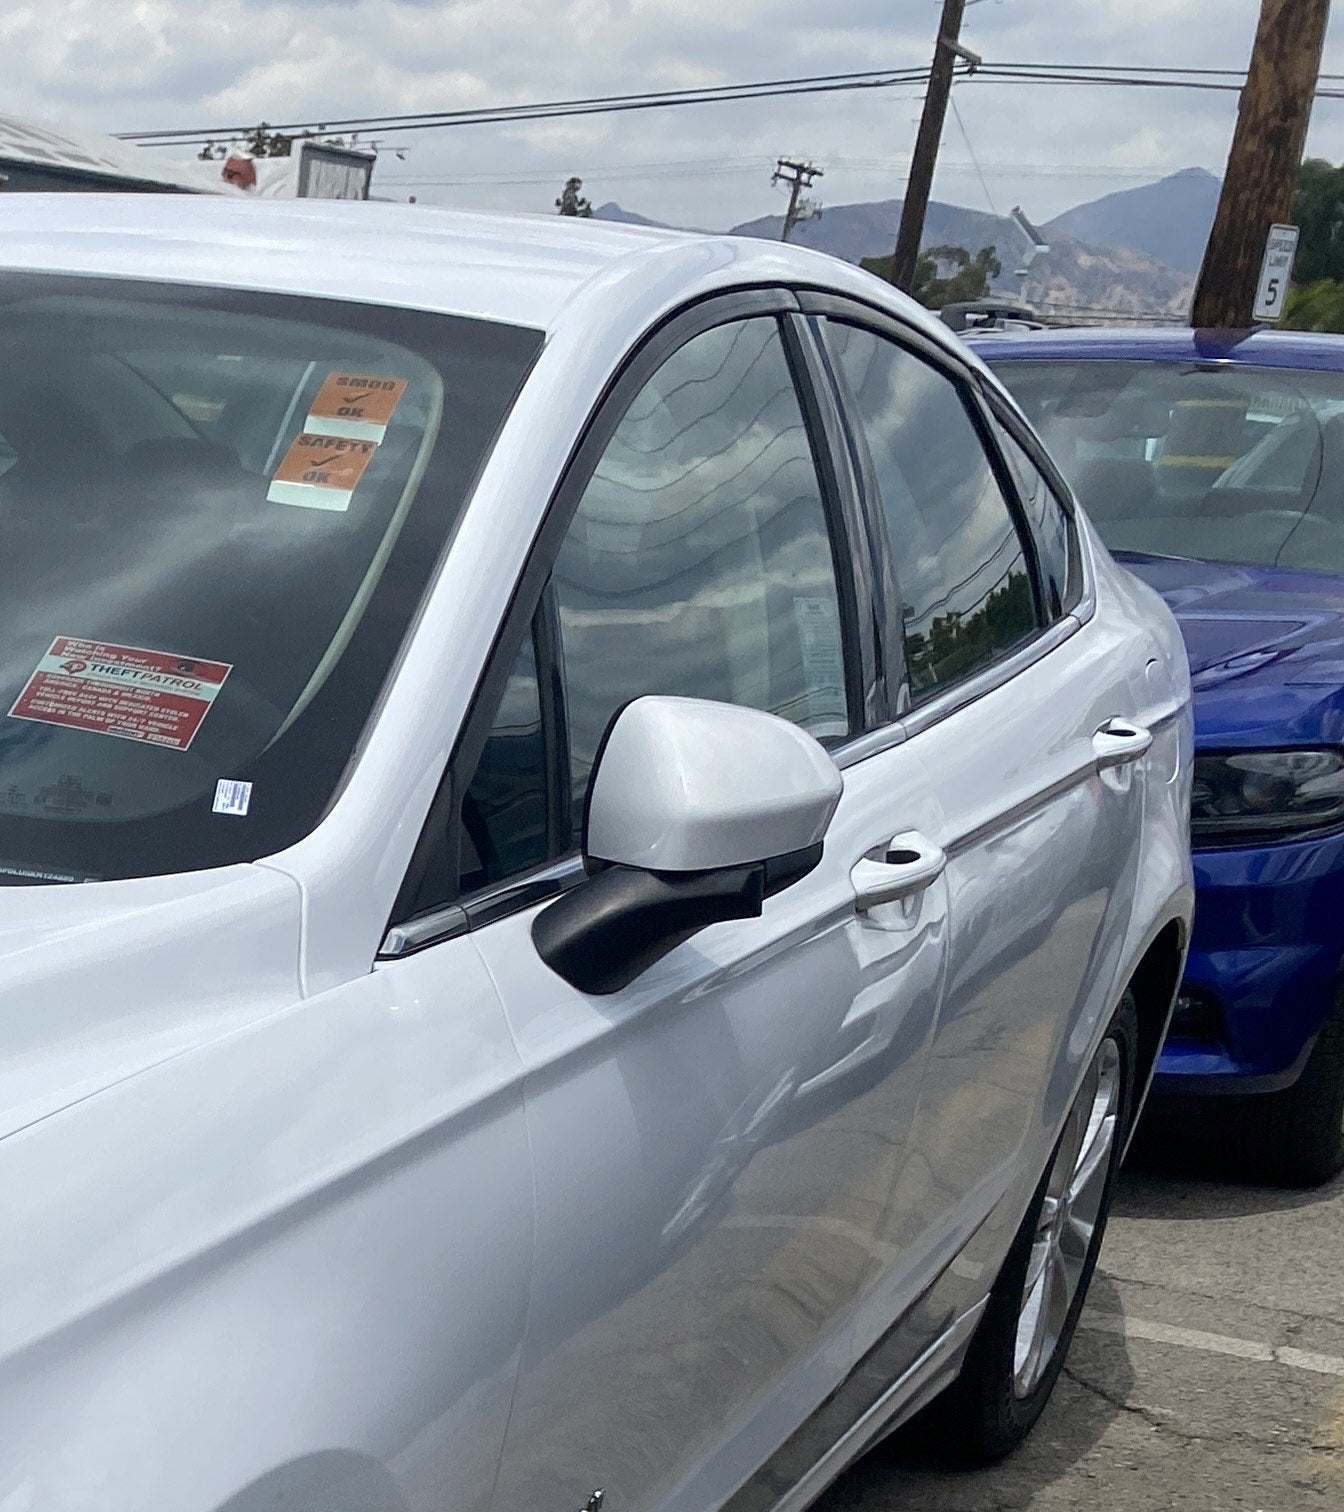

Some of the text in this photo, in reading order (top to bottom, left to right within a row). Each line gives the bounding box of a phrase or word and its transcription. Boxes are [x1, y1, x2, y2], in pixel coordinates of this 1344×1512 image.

[1265, 279, 1279, 306] 5
[336, 377, 395, 391] SMOG
[336, 407, 364, 417] OK
[298, 435, 375, 453] SAFETY
[303, 471, 331, 483] OK
